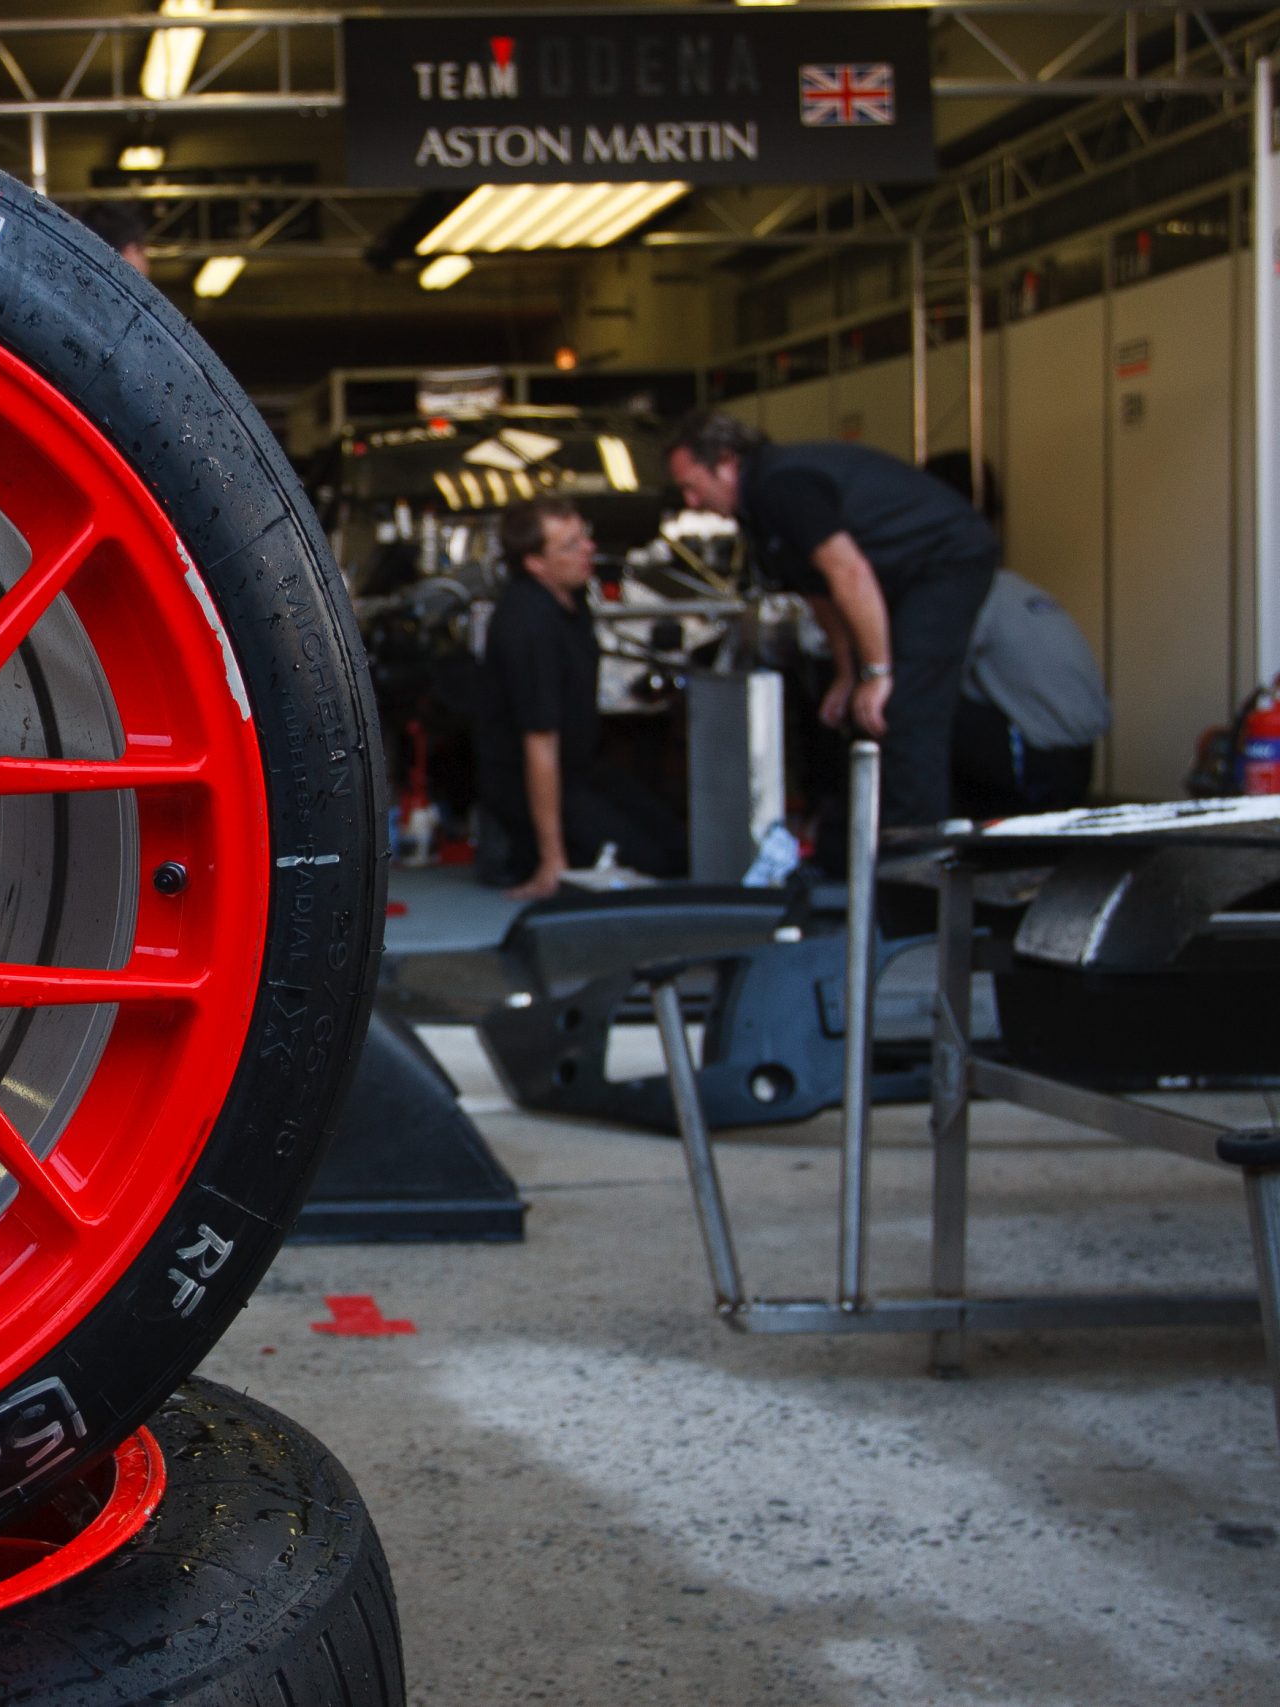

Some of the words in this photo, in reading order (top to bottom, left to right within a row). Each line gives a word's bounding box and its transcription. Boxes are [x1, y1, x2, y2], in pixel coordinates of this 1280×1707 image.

[414, 62, 519, 99] TEAM
[416, 125, 572, 168] ASTON
[583, 121, 759, 163] MARTIN
[277, 574, 352, 798] MICHELIN
[167, 1223, 234, 1319] RF
